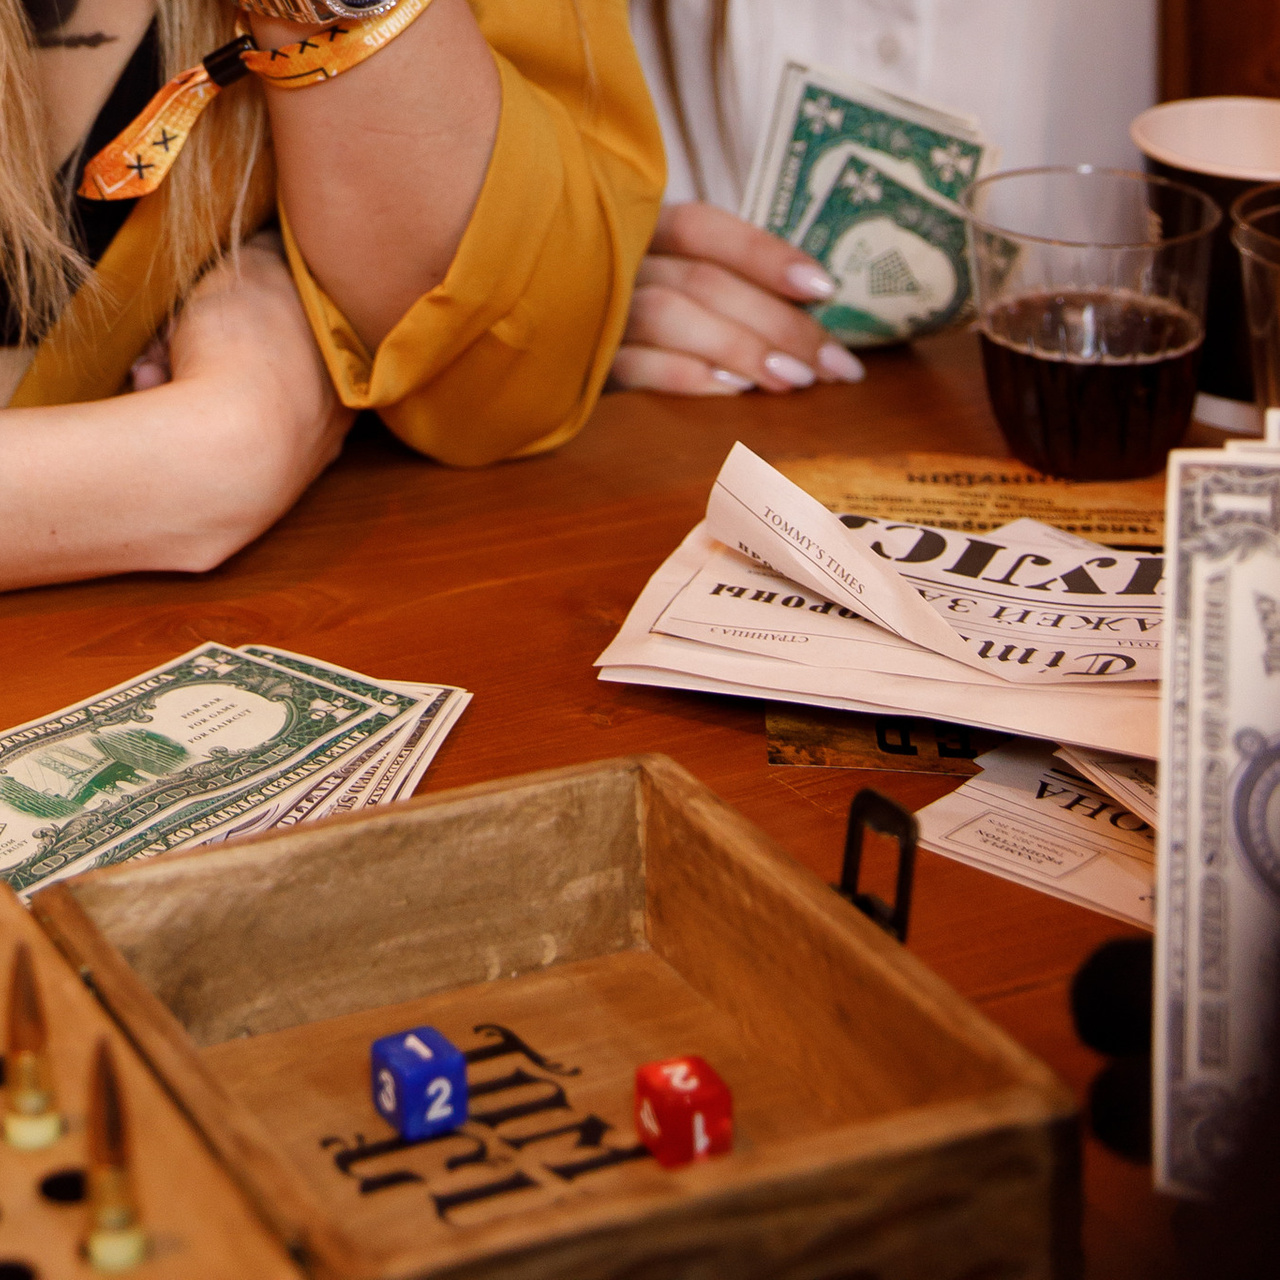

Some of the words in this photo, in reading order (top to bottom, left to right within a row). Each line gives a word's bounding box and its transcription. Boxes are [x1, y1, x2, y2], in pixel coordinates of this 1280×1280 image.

[764, 506, 826, 560] TOMMY'S
[825, 554, 866, 595] TIMES
[722, 628, 809, 644] СТРАНИЦА
[958, 633, 1138, 676] Tim
[1203, 570, 1231, 706] AMERICA
[59, 707, 90, 726] OF
[87, 672, 177, 716] AMERICA
[180, 707, 202, 720] FOR
[201, 696, 224, 709] BAR
[187, 717, 209, 730] FOR
[208, 702, 239, 719] GAME
[187, 731, 210, 744] FOR
[208, 708, 253, 734] HAIRCUT
[260, 755, 333, 798] UNITED
[30, 818, 125, 876] ONE
[121, 743, 299, 827] DOLLAR
[192, 792, 265, 833] STATES
[275, 773, 345, 830] OLLAR
[1035, 779, 1156, 840] ОНА
[0, 839, 29, 857] TRUST
[974, 828, 1064, 866] PRODUCTION
[404, 1033, 434, 1060] 1
[662, 1063, 701, 1091] 2
[426, 1076, 454, 1122] 2
